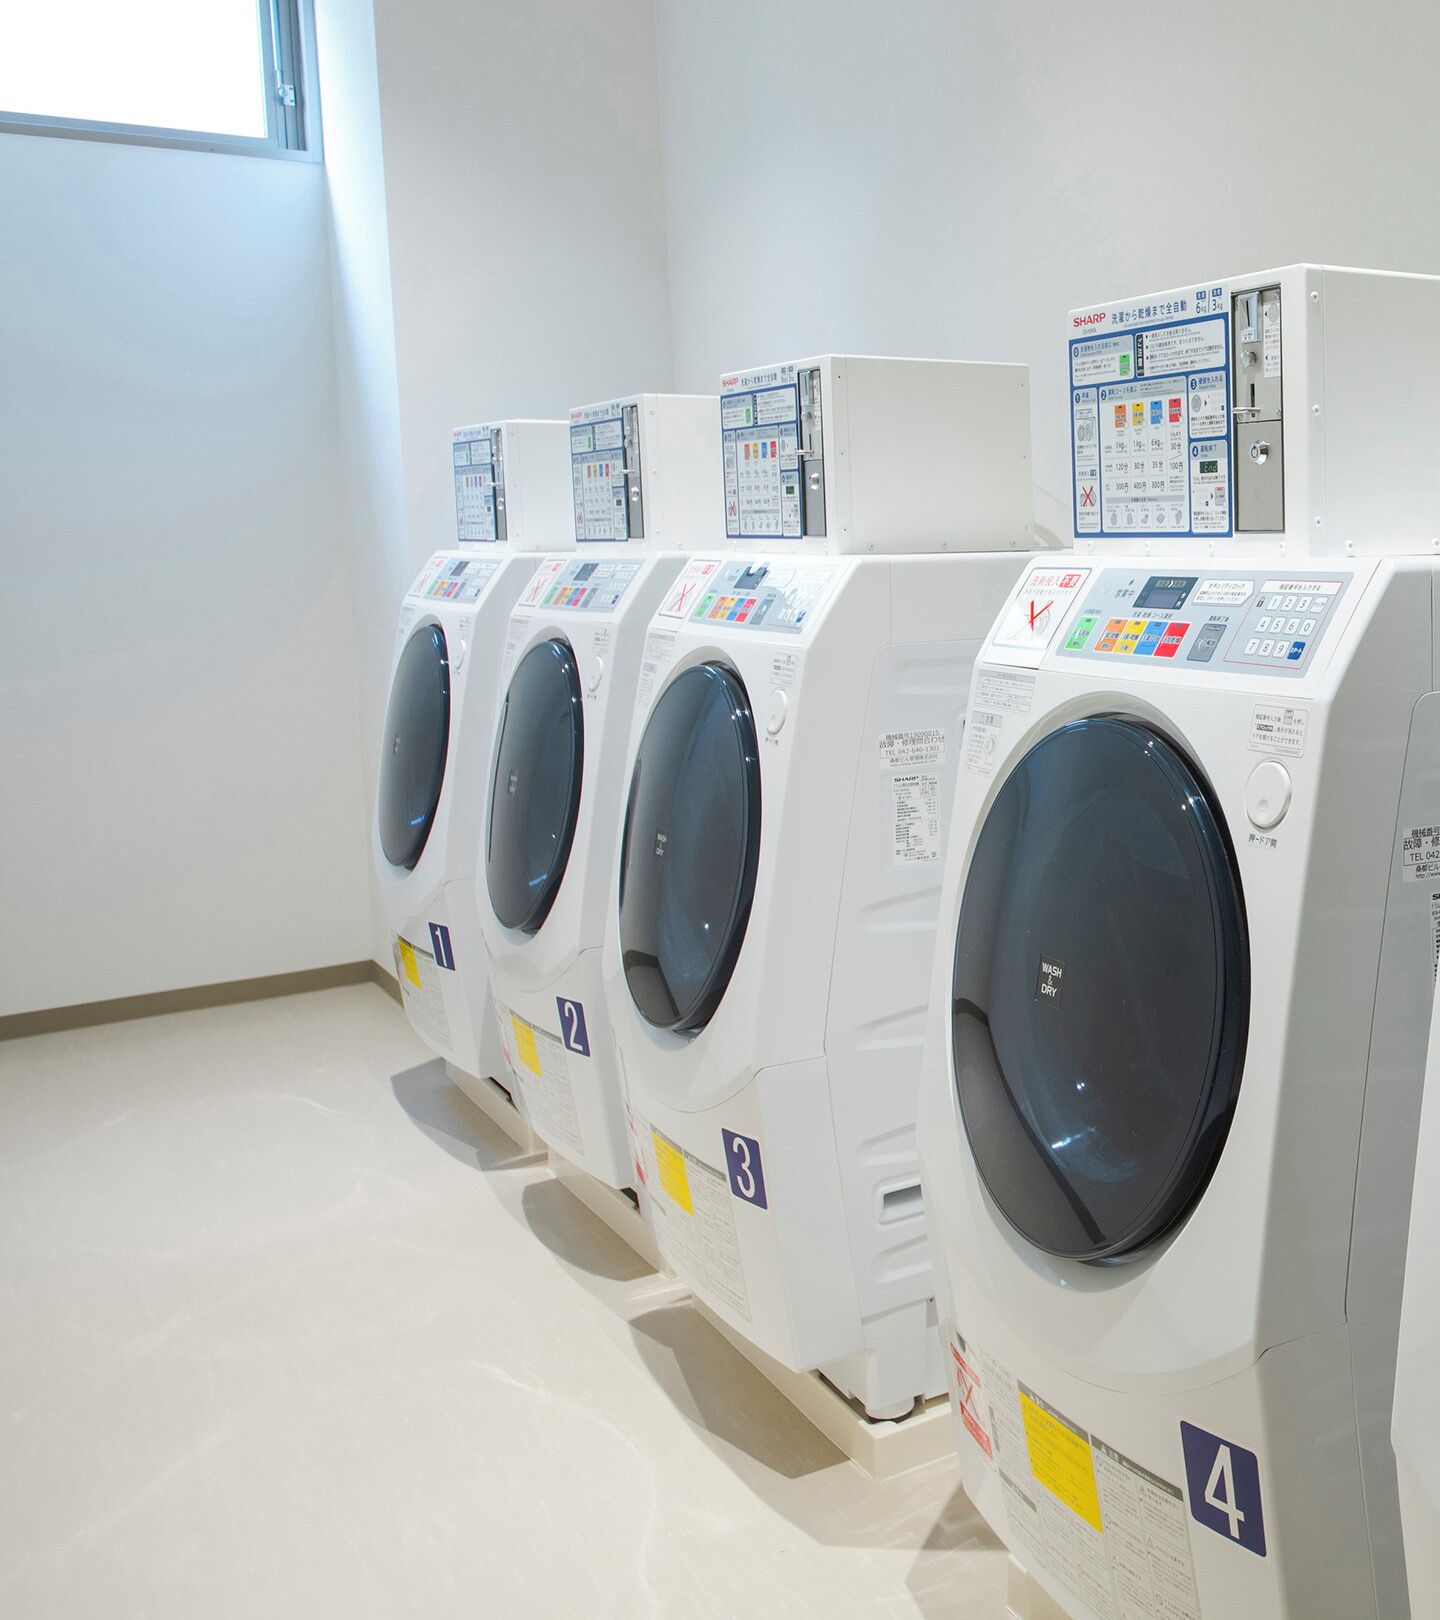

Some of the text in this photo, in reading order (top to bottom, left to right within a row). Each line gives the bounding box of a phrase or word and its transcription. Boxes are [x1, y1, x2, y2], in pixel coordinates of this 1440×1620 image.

[1073, 312, 1106, 328] SHARP
[1285, 599, 1293, 608] 2
[1299, 599, 1306, 608] 3
[1260, 619, 1267, 628] 4
[1273, 621, 1280, 630] 5
[1288, 621, 1295, 630] 6
[1263, 644, 1270, 653] 8
[1278, 645, 1285, 653] 9
[1410, 852, 1424, 862] TEL
[434, 925, 448, 968] 1
[1042, 962, 1062, 978] WASH
[1041, 983, 1057, 997] DRY
[564, 1000, 584, 1052] 2
[733, 1136, 756, 1199] 3
[1204, 1444, 1245, 1540] 4
